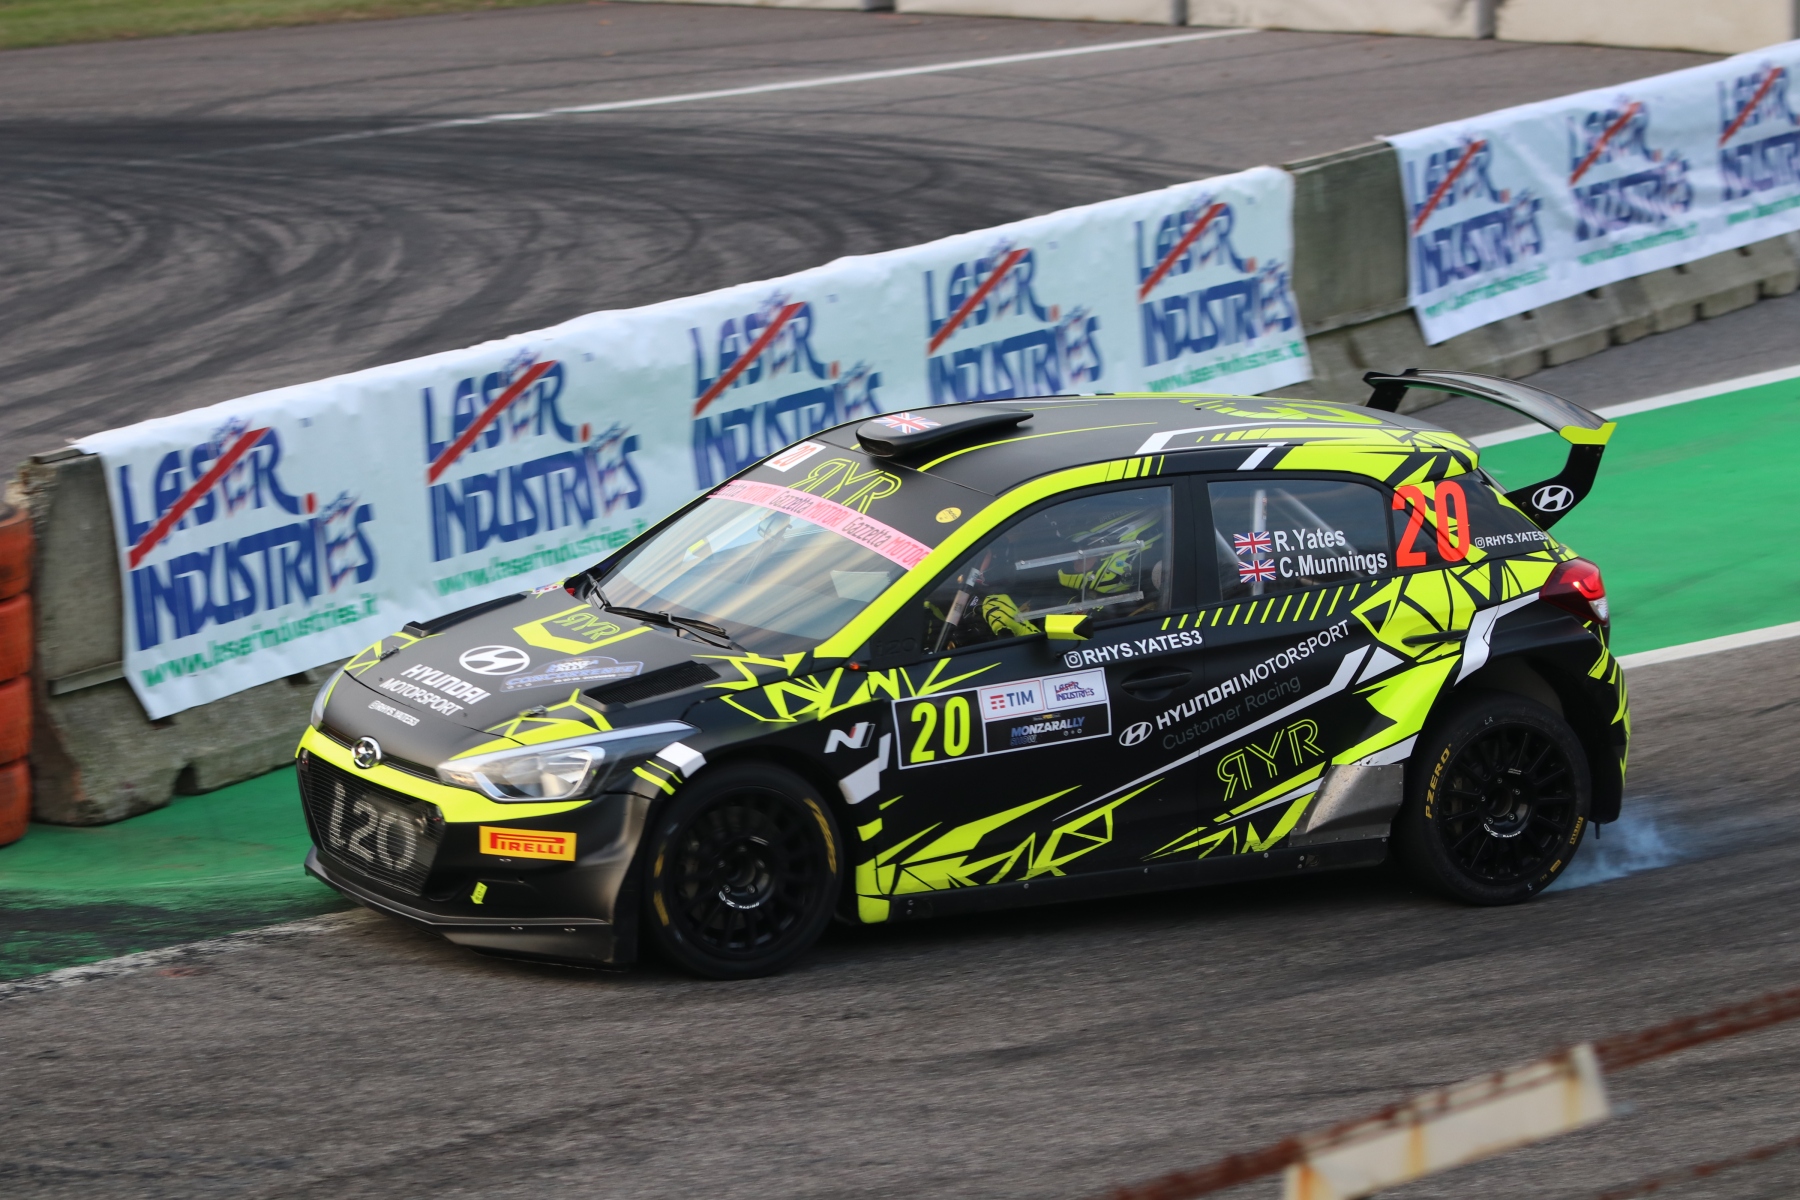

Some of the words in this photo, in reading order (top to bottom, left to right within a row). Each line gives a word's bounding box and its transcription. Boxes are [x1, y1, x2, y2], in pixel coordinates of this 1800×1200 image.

[1142, 260, 1297, 366] INDUSTRIES
[773, 444, 815, 467] 20
[429, 424, 646, 562] INDUSTRIES
[769, 490, 814, 513] Gazzetta
[803, 502, 852, 528] MOTORI
[841, 516, 892, 548] Gazzetta
[1274, 529, 1346, 553] R.Yates
[1392, 480, 1471, 568] 20
[130, 493, 378, 650] INDUSTRIES
[1279, 550, 1388, 580] C.Munnings
[379, 677, 464, 716] MOTORSPORT
[400, 664, 491, 705] HYUNDAI
[1006, 689, 1034, 707] TIM
[1056, 688, 1095, 701] INDUSTRIES
[1156, 676, 1240, 730] HYUNDAI
[1240, 619, 1350, 689] MOTORSPORT
[910, 696, 970, 763] 20
[1162, 703, 1241, 750] Customer
[1246, 676, 1302, 714] Racing
[490, 831, 566, 855] PIRELLI
